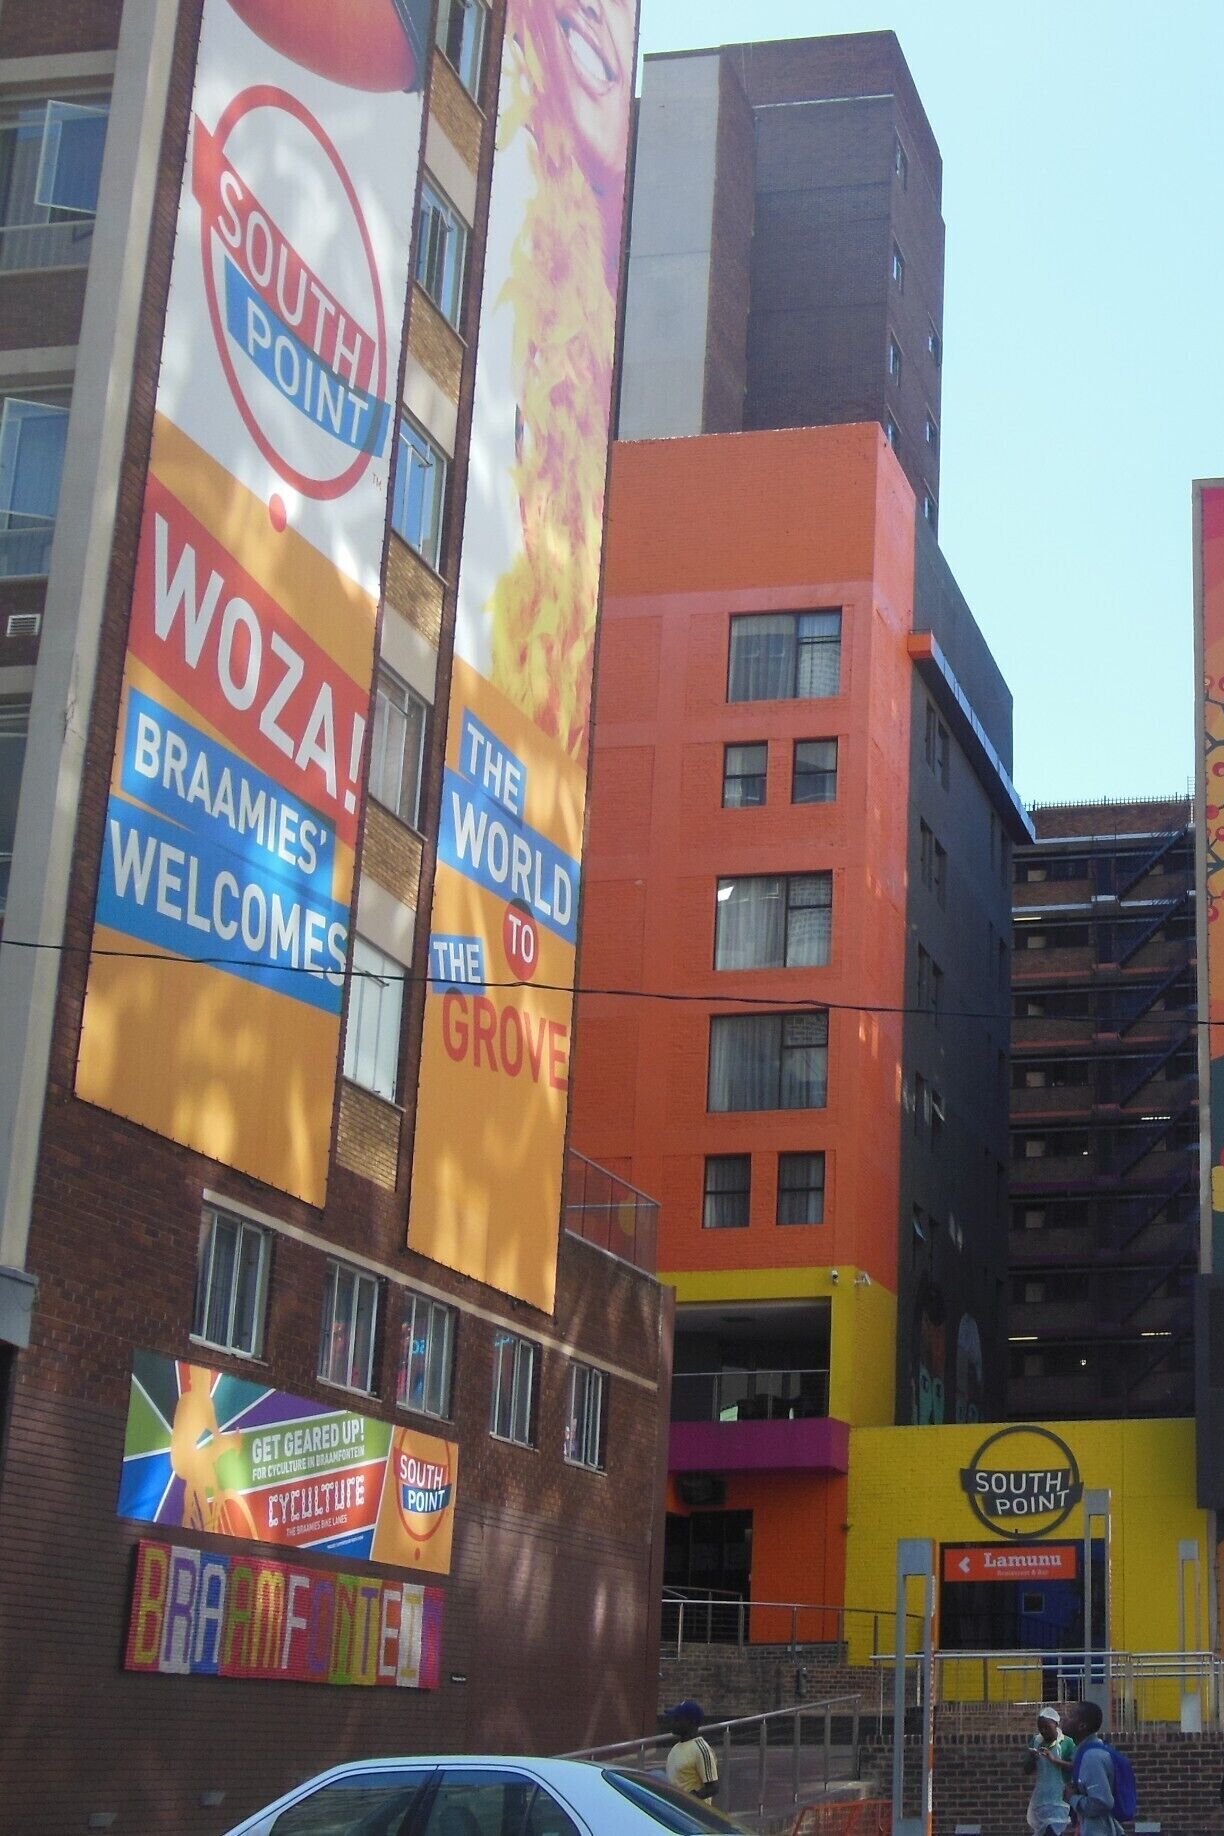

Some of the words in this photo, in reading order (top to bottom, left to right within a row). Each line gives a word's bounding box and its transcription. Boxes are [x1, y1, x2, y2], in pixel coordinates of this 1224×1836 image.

[218, 171, 362, 389] SOUTH
[247, 297, 368, 443] POINT
[155, 512, 366, 815] WOZA!
[466, 723, 521, 815] THE
[452, 791, 572, 925] WORLD
[110, 819, 348, 987] WELCOMES
[433, 941, 482, 984] THE
[508, 914, 535, 963] TO
[442, 987, 568, 1092] GROVE
[252, 1468, 267, 1481] FOR
[267, 1459, 307, 1477] CYCULTURE
[307, 1456, 314, 1469] IN
[316, 1445, 365, 1466] BRAAMFONTEIN
[253, 1434, 281, 1463] GET
[284, 1423, 340, 1456] GEARED
[343, 1418, 365, 1444] UP!
[400, 1454, 443, 1490] SOUTH
[975, 1471, 1062, 1494] SOUTH
[268, 1474, 365, 1528] CYCULTURE
[321, 1517, 332, 1530] BIKE
[332, 1514, 348, 1527] LANES
[408, 1490, 446, 1512] POINT
[996, 1489, 1070, 1515] POINT
[984, 1553, 1062, 1568] Lamunu
[133, 1547, 444, 1681] BRAAMFONTEIN
